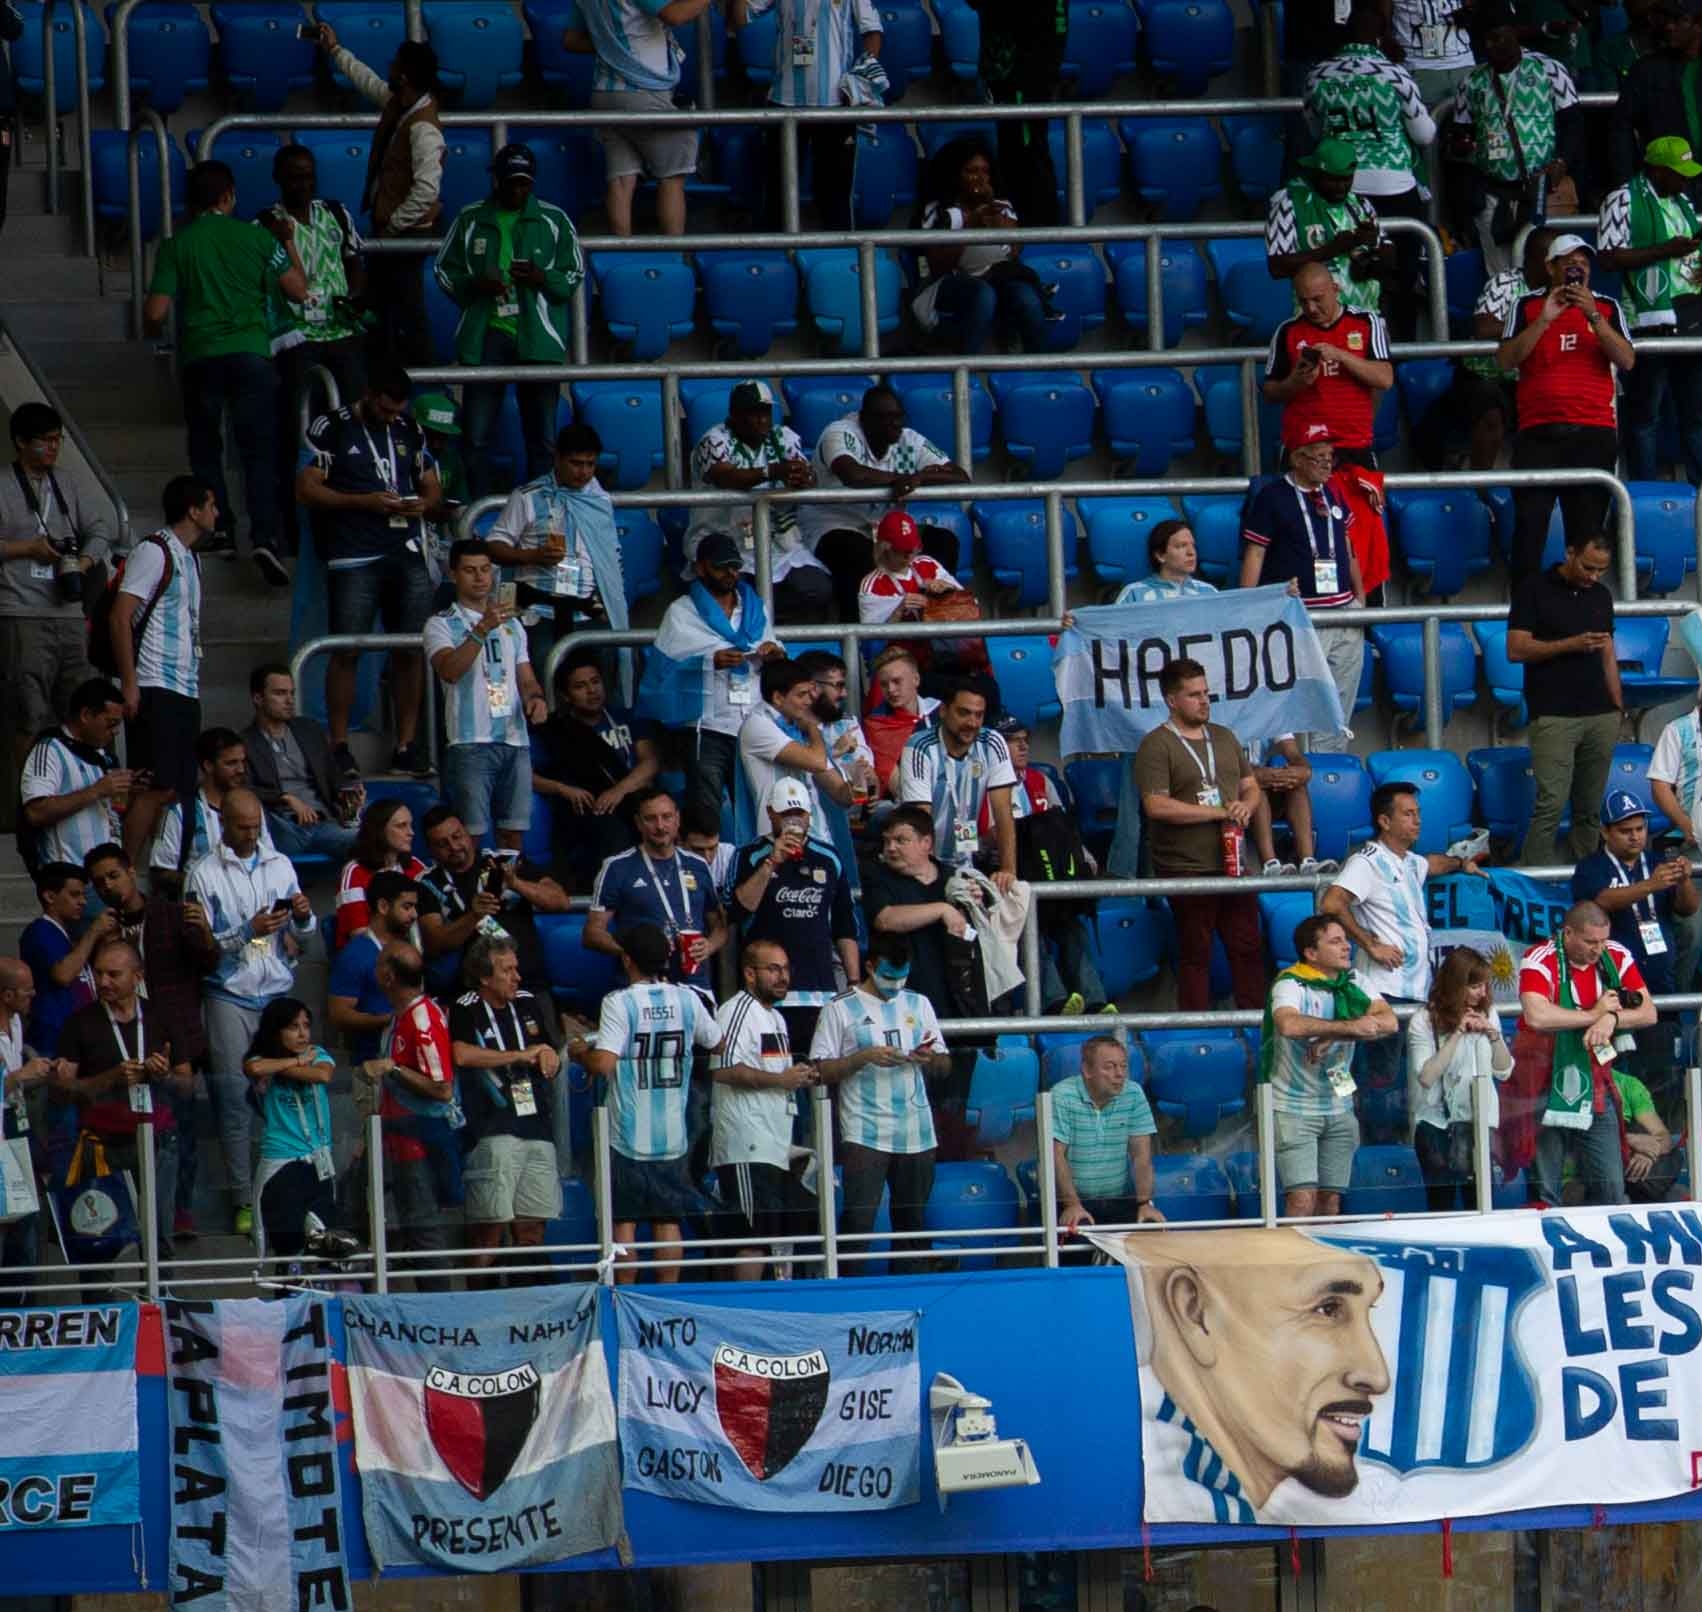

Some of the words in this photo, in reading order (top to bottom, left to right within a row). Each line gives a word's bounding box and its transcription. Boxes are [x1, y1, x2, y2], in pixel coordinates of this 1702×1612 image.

[1560, 333, 1577, 352] 12
[643, 1005, 676, 1021] MESSI
[636, 1029, 686, 1090] 10
[345, 1308, 481, 1348] CHANCHA
[1557, 1268, 1702, 1357] LES
[639, 1316, 697, 1349] NITO
[468, 1365, 535, 1394] COLON
[760, 1351, 825, 1378] COLON
[646, 1376, 706, 1415] LUCY
[839, 1389, 893, 1421] GISE
[1562, 1357, 1683, 1443] DE
[637, 1444, 723, 1486] GASTON
[818, 1460, 894, 1499] DIEGO
[0, 1475, 97, 1525] CE
[412, 1508, 562, 1555] PRESENTE
